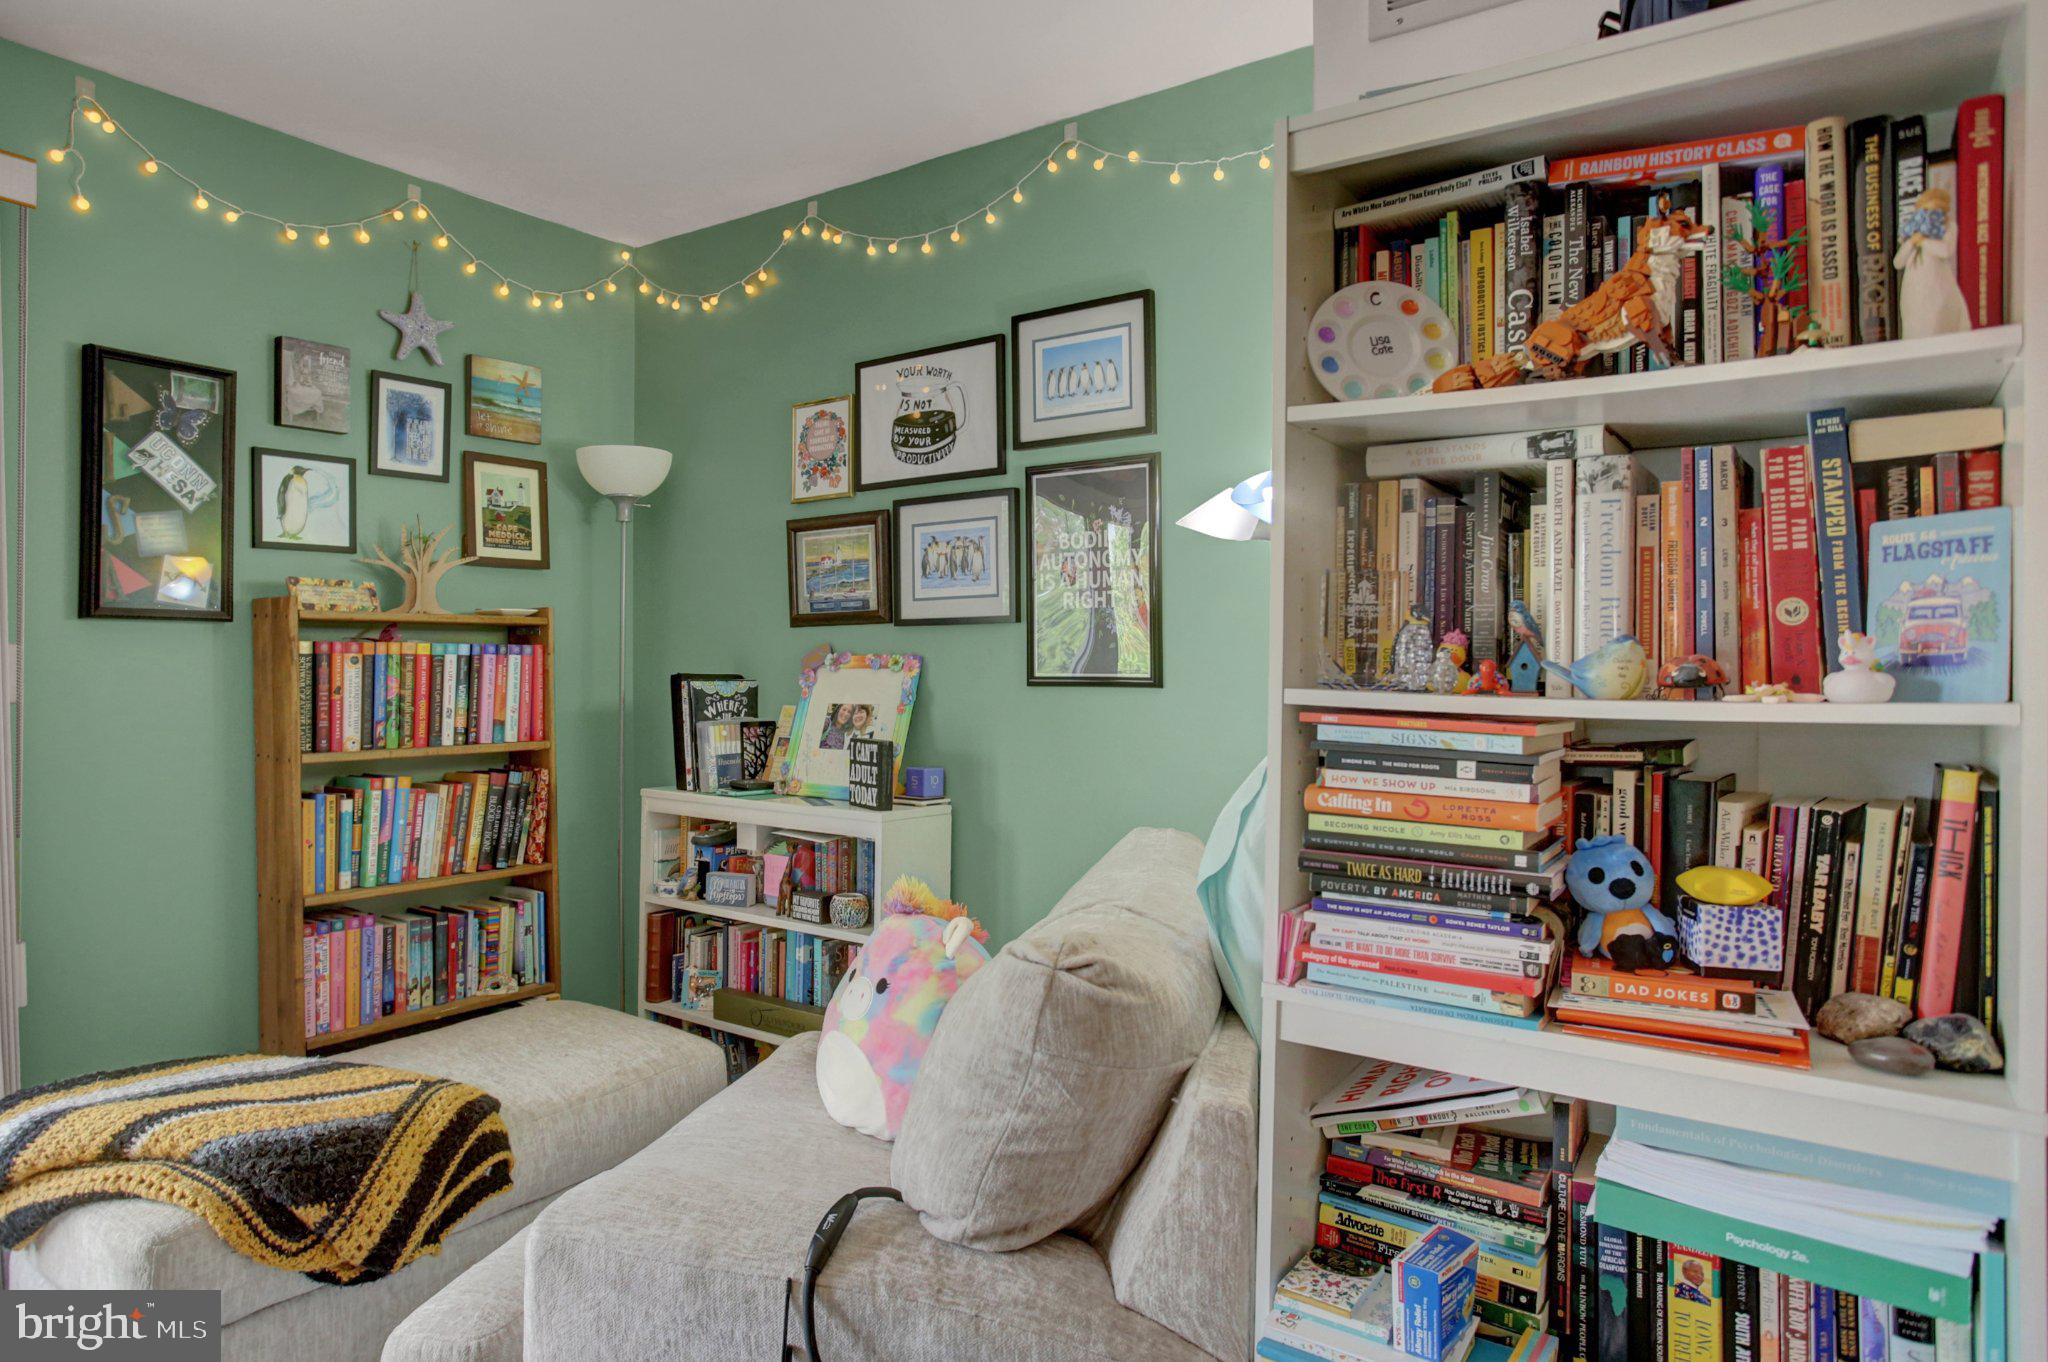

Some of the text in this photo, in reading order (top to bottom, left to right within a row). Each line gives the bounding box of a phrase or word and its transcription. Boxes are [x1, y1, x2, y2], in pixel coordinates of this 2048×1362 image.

[1817, 126, 1834, 151] HOW
[1864, 134, 1879, 162] THE
[1579, 137, 1768, 176] RAINBOW HISTORY CLASS
[1819, 157, 1835, 177] THE
[1759, 171, 1778, 182] THE
[1352, 204, 1370, 216] White
[1370, 201, 1382, 211] Men
[1382, 196, 1407, 208] Smarter
[1408, 192, 1423, 203] Than
[1424, 183, 1455, 199] Everybody
[1456, 178, 1472, 189] Else?
[1820, 182, 1837, 216] WORD
[1864, 165, 1880, 229] BUSINESS
[1520, 216, 1533, 256] Isabel
[1549, 221, 1562, 229] THE
[1821, 220, 1837, 232] IS
[1507, 204, 1519, 272] Wilkerson
[1866, 231, 1881, 250] OF
[1548, 232, 1562, 270] COLOR
[1568, 236, 1584, 266] The
[1821, 236, 1838, 280] PASSED
[1548, 283, 1563, 305] LAW
[1568, 267, 1584, 300] New
[896, 365, 953, 381] YOUR WORTH
[476, 410, 491, 422] let
[900, 399, 932, 411] IS NOT
[893, 434, 932, 446] BY YOUR
[894, 426, 931, 435] MEASURED
[149, 434, 210, 492] UCONN
[896, 441, 955, 465] PRODUCTIVITY
[1768, 456, 1788, 551] THE BEGINNING
[1788, 454, 1808, 550] STAMPED FROM
[1647, 502, 1656, 531] WILLIAM
[1058, 529, 1110, 549] BODIL
[1477, 531, 1494, 557] Jim
[1821, 457, 1849, 637] STAMPED FROM THE BEGIN
[1882, 529, 1937, 545] ROUTE 66
[1882, 534, 1995, 563] FLAGSTAFF
[1039, 548, 1143, 571] AUTONOMY
[1553, 466, 1564, 664] ELIZABETH AND HAZEL DAVID MARGOL
[1040, 573, 1056, 591] IS
[1077, 568, 1144, 590] HUMAN
[1463, 512, 1475, 632] Slavery by Another Name
[1480, 559, 1493, 594] Crow
[1062, 590, 1117, 609] RIGHT
[703, 699, 748, 720] WHERE'S
[1390, 733, 1438, 747] SIGNS
[850, 742, 878, 764] I CAN'T
[849, 763, 878, 786] ADULT
[911, 775, 920, 786] 5
[930, 775, 939, 786] 10
[1331, 774, 1358, 785] HOW
[1361, 776, 1378, 786] WE
[1381, 778, 1417, 790] SHOW
[1420, 780, 1437, 791] UP
[1458, 786, 1497, 795] BIRDSONG
[849, 784, 878, 807] TODAY
[1317, 791, 1393, 815] Calling In
[1616, 788, 1629, 819] good
[486, 795, 497, 822] BLOOD
[1442, 804, 1497, 815] LORETTA
[482, 831, 492, 852] BONE
[1324, 820, 1369, 832] BECOMING
[1372, 824, 1406, 835] NICOLE
[1429, 829, 1446, 839] Amy
[1464, 831, 1482, 841] Nutt
[1719, 808, 1731, 859] Alice Walker
[1938, 820, 1969, 881] THICK
[1772, 834, 1785, 893] BELOVED
[1373, 886, 1388, 897] BY
[1391, 888, 1441, 902] AMERICA
[1344, 941, 1355, 951] WE
[1356, 942, 1375, 953] WANT
[1376, 944, 1384, 954] TO
[1385, 945, 1393, 955] DO
[1394, 946, 1412, 957] MORE
[1413, 948, 1431, 960] THAN
[1431, 950, 1457, 964] SURVIVE
[1379, 978, 1430, 994] PALESTINE
[1614, 983, 1710, 1004] DAD JOKES
[1464, 1107, 1511, 1118] BALLESTEROS
[1629, 1118, 1882, 1178] Fundamentals of Psychological Disorders
[1376, 1169, 1398, 1188] The
[1401, 1175, 1427, 1197] First
[1432, 1185, 1442, 1199] R
[1334, 1212, 1385, 1238] Advocate
[1557, 1174, 1567, 1282] CULTURE ON THE MARGINS
[1578, 1205, 1588, 1245] DESMOND
[1602, 1236, 1623, 1244] GLOBAL
[1578, 1246, 1588, 1267] TUTU
[1599, 1263, 1628, 1274] DIASPORA
[1600, 1256, 1628, 1266] AFRICAN
[1578, 1284, 1588, 1322] RAINBOW
[1734, 1263, 1751, 1346] HISTORY SOUTH
[1578, 1323, 1588, 1348] PEOPLE
[1694, 1319, 1712, 1356] LONG
